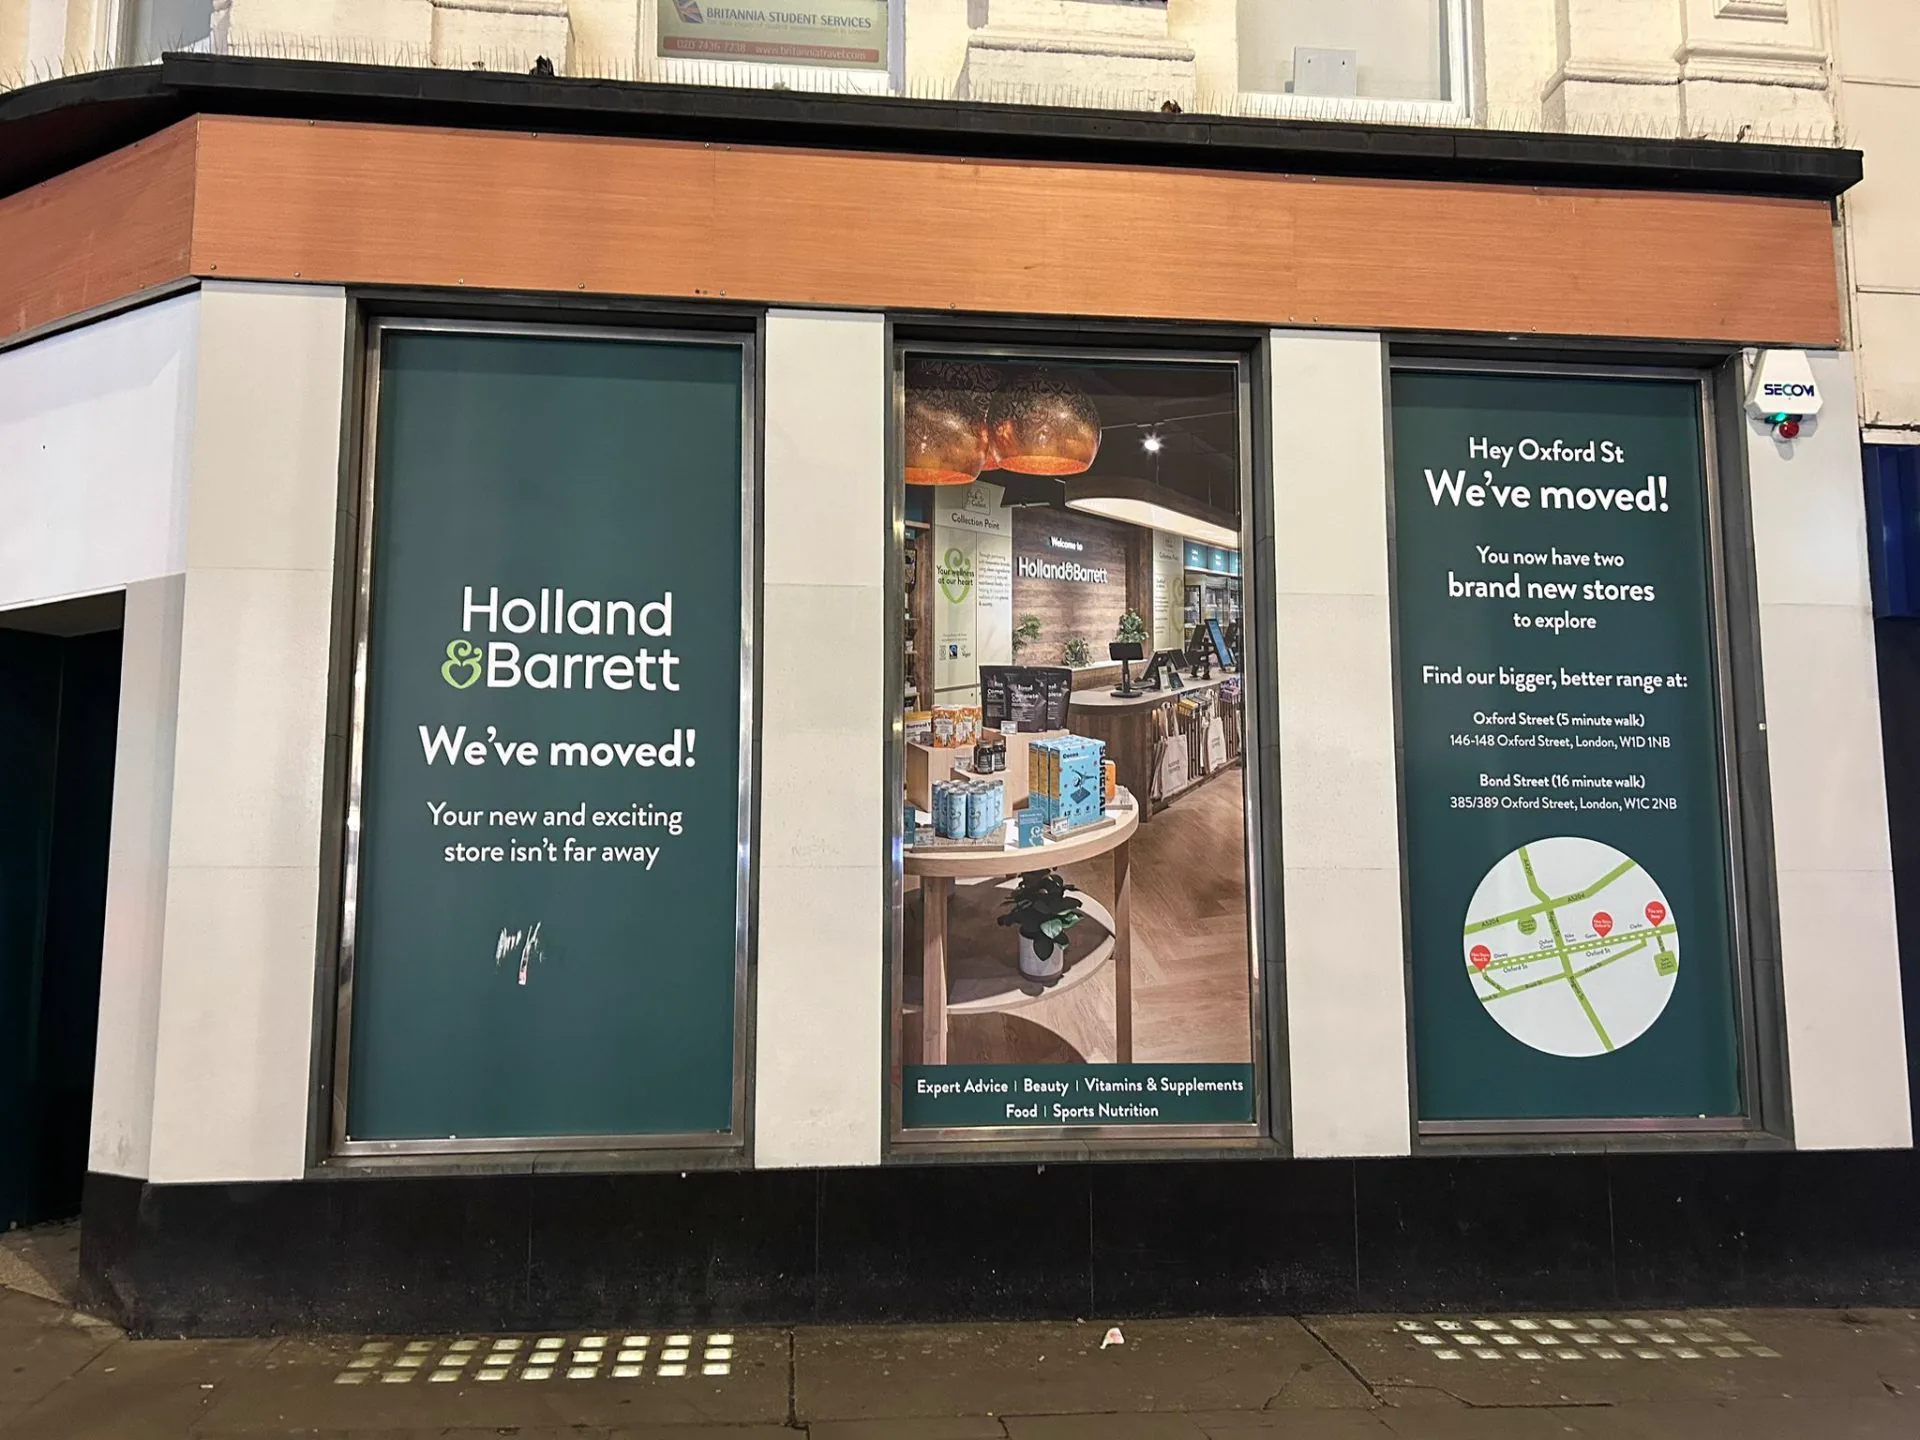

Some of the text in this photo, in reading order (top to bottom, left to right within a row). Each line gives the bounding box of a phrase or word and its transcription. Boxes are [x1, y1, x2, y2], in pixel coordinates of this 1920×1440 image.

[706, 7, 765, 22] BRITANNIA
[768, 11, 817, 25] STUDENT
[820, 14, 872, 29] SERVICES
[1764, 384, 1814, 397] SECOM
[1470, 437, 1624, 467] Hey Oxford St
[1424, 469, 1668, 512] We've moved!
[951, 512, 1000, 530] Collection Point
[1050, 536, 1083, 551] Welcome to
[1476, 546, 1624, 566] You now have two
[936, 565, 950, 575] Your
[958, 577, 973, 586] heart
[1449, 572, 1655, 601] brand new stores
[462, 586, 672, 636] Holland
[1514, 611, 1596, 634] to explore
[1423, 666, 1687, 694] Find our bigger, better range at:
[1474, 712, 1644, 727] Oxford Street (5 minute walk)
[419, 726, 695, 767] We've moved!
[1450, 735, 1670, 749] 146-148 Oxford Street, London, W1D 1NB
[1480, 774, 1645, 788] Bond Street (16 minute walk)
[1451, 797, 1677, 811] 385/389 Oxford Street, London, W1C 2NB
[427, 802, 682, 835] Your new and exciting
[445, 838, 659, 870] store isn't far away
[918, 1078, 1243, 1098] Expert Advice Beauty Vitamins & Supplements
[1007, 1103, 1158, 1122] Food Sports Nutrition
